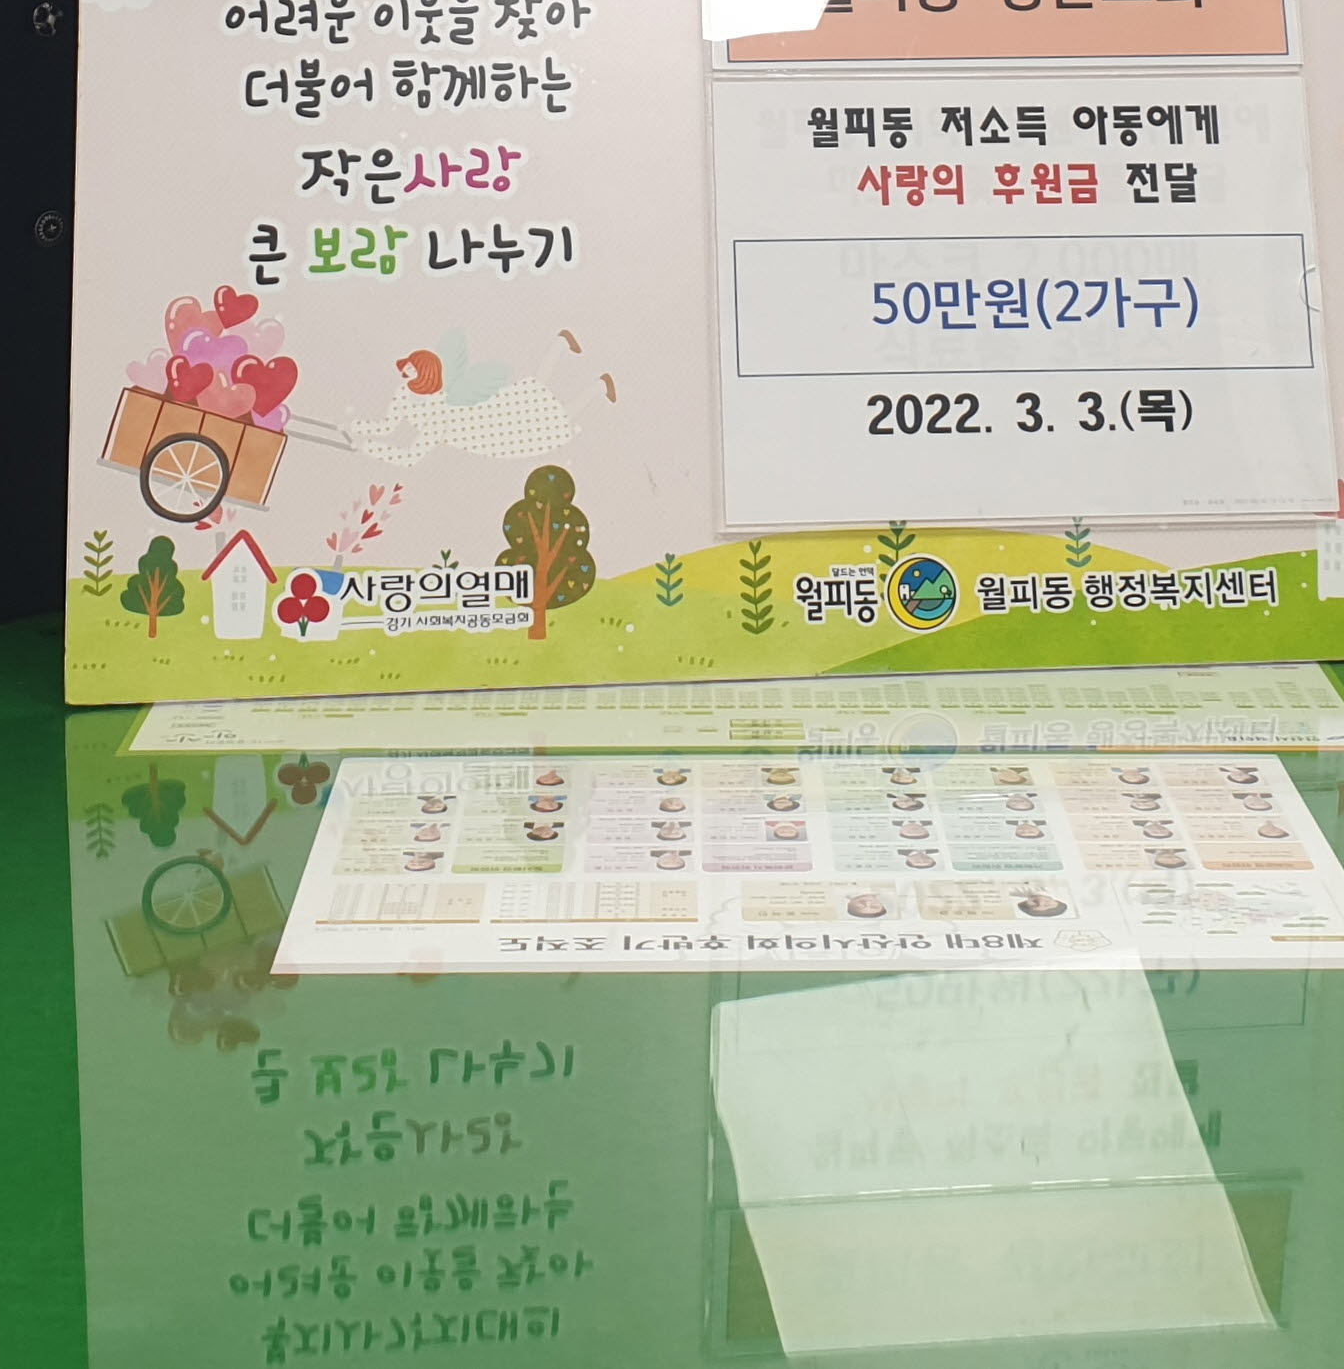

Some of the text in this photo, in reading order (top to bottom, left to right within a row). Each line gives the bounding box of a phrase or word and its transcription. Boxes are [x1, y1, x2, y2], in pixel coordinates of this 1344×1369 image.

[245, 56, 572, 118] 더불어 함께하는
[807, 104, 1221, 149] 월피동 저소득 아동에게
[857, 162, 1199, 207] 사랑의 후원금 전달
[248, 223, 573, 286] 큰 보람 나누기
[872, 276, 1199, 331] 50만원(2가구)
[867, 389, 1194, 435] 2022. 3. 3.(목)
[340, 570, 528, 613] 사랑의열매
[796, 576, 878, 623] 월피동
[977, 570, 1277, 611] 월피동 행정복지센터
[386, 612, 529, 631] 경기 사회복지공동모금회
[499, 933, 1044, 953] 제8대 안산시의회 후반기 조직도
